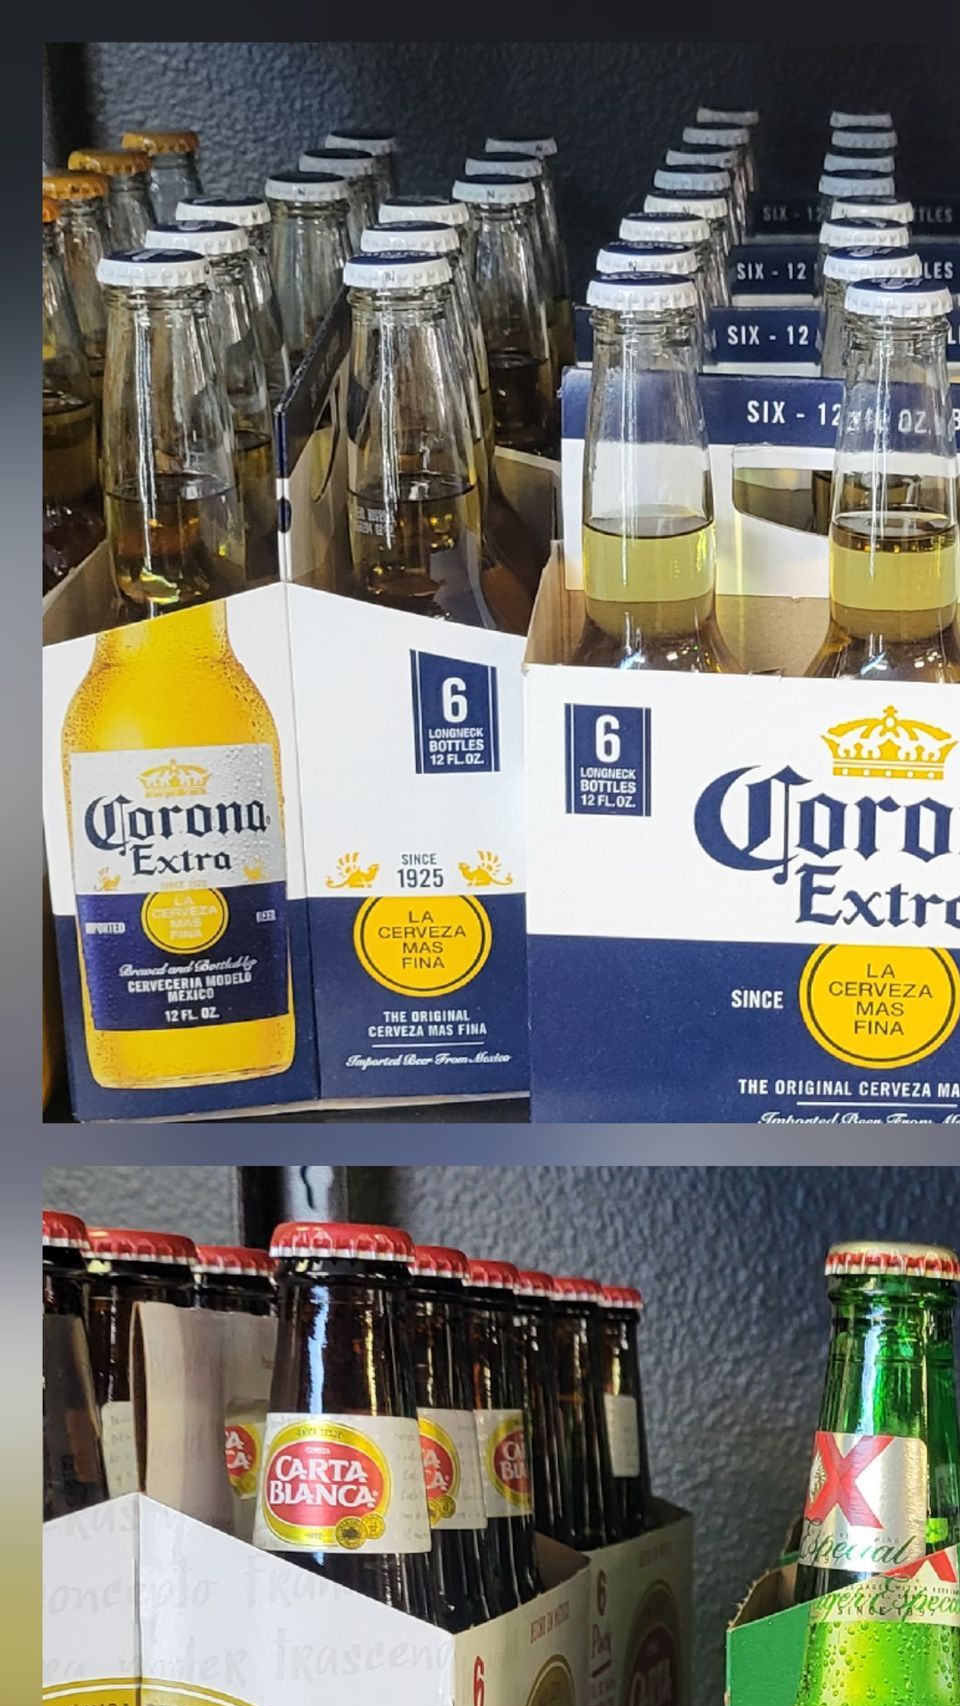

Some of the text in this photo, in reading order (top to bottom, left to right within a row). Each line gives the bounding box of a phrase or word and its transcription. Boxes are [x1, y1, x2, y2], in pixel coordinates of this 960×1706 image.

[748, 401, 785, 424] SIX
[818, 403, 842, 426] 12
[441, 677, 468, 724] 6
[429, 728, 484, 740] LONGNECK
[595, 714, 621, 762] 6
[429, 739, 484, 753] BOTTLES
[580, 768, 636, 780] LONGNECK
[580, 780, 637, 794] BOTTLES
[84, 795, 269, 852] Corona
[131, 844, 233, 877] Extra
[401, 853, 437, 866] SINCE
[397, 869, 444, 889] 1925
[408, 910, 433, 924] LA
[378, 925, 467, 940] CERVEZA
[402, 941, 443, 955] MAS
[401, 956, 445, 970] FINA
[866, 963, 895, 979] LA
[168, 988, 214, 1002] MEXICO
[828, 981, 933, 999] CERVEZA
[731, 989, 784, 1009] SINCE
[165, 1010, 179, 1022] 12
[383, 1009, 470, 1023] THE ORIGINAL
[856, 1002, 905, 1017] MAS
[368, 1022, 487, 1038] CERVEZA MAS FINA
[853, 1020, 905, 1036] FINA
[738, 1079, 768, 1095] THE
[775, 1080, 852, 1097] ORIGINAL
[859, 1081, 931, 1099] CERVEZA
[275, 1455, 368, 1483] CARTA
[269, 1480, 379, 1508] BLANCA
